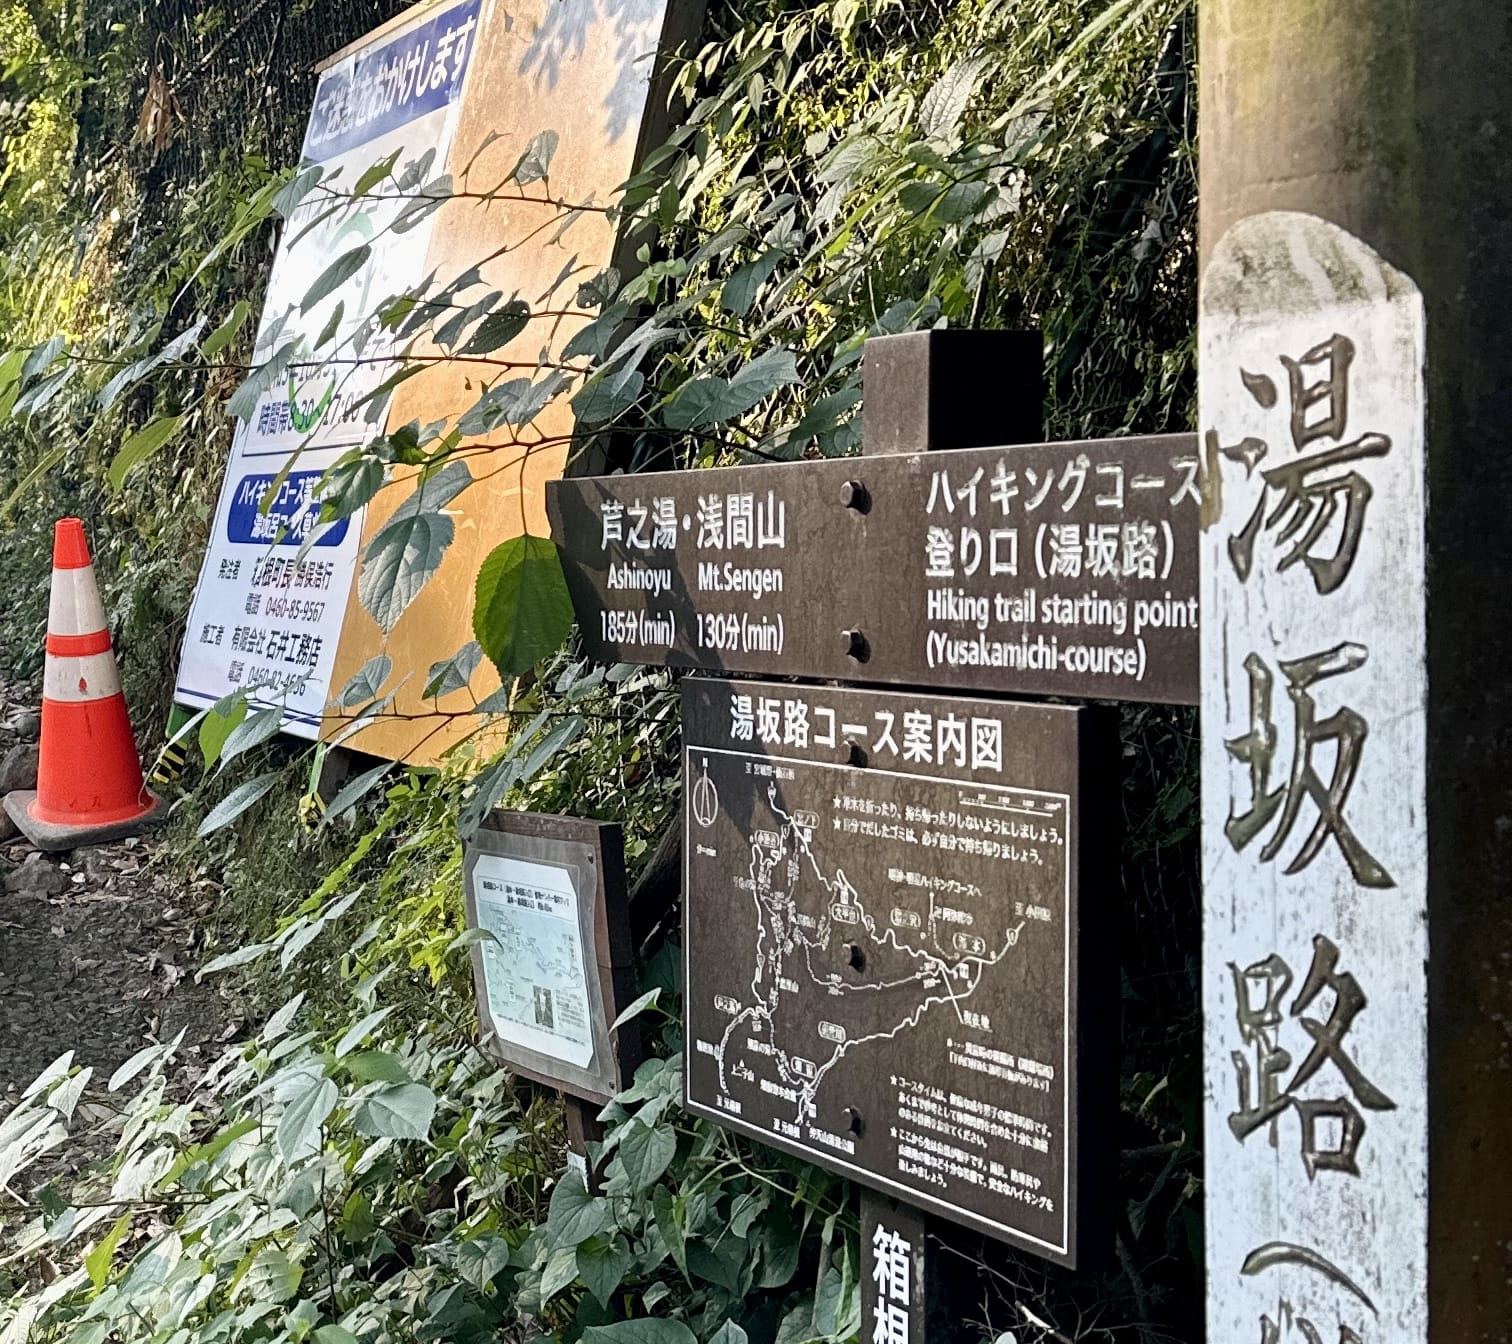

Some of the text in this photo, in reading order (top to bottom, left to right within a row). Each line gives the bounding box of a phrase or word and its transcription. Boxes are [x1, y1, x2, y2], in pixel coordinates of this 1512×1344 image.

[926, 453, 1202, 516] ハイキングコース
[607, 561, 783, 600] Ashinoyu Mt.Sengen
[265, 596, 326, 623] 0460-85-9567
[600, 609, 784, 655] 185分(min) 130分(min)
[928, 588, 1199, 636] Hiking trail starting point
[231, 624, 267, 655] 有限会社
[266, 629, 323, 668] 石井工務店
[926, 630, 1146, 681] (Yusakamichi-course)
[730, 694, 1002, 772] 湯坂路コース案内図
